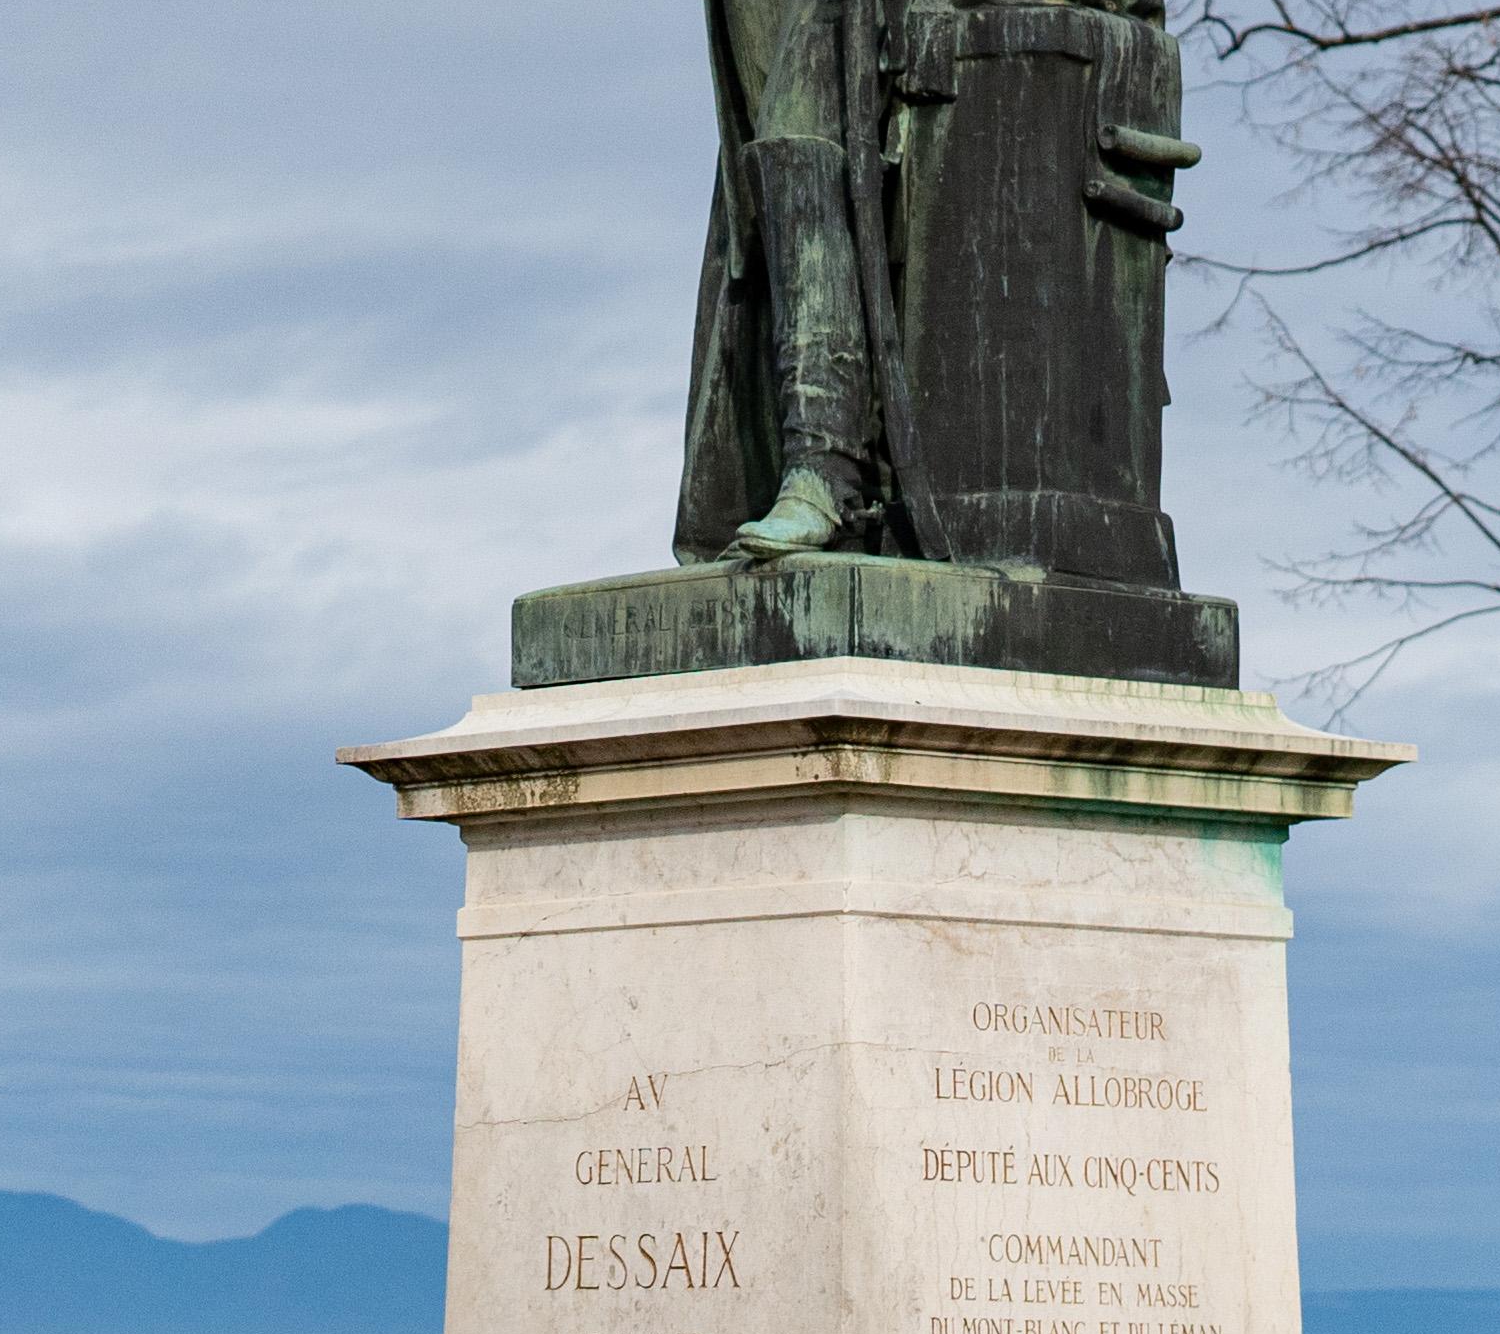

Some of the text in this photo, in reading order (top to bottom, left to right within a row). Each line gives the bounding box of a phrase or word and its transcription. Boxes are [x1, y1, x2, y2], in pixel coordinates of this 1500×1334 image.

[972, 1002, 1167, 1041] ORGANISATEUR
[1048, 1046, 1095, 1063] DE LA
[935, 1062, 1208, 1112] LÉGION ALLOBROGE
[575, 1145, 720, 1185] GENERAL
[923, 1143, 1220, 1197] DÉPUTÉ AUX CINQ-CENTS
[545, 1230, 741, 1291] DESSAIX
[989, 1234, 1162, 1268] COMMANDANT
[950, 1276, 1200, 1309] DE LA LEVÉE EN MASSE
